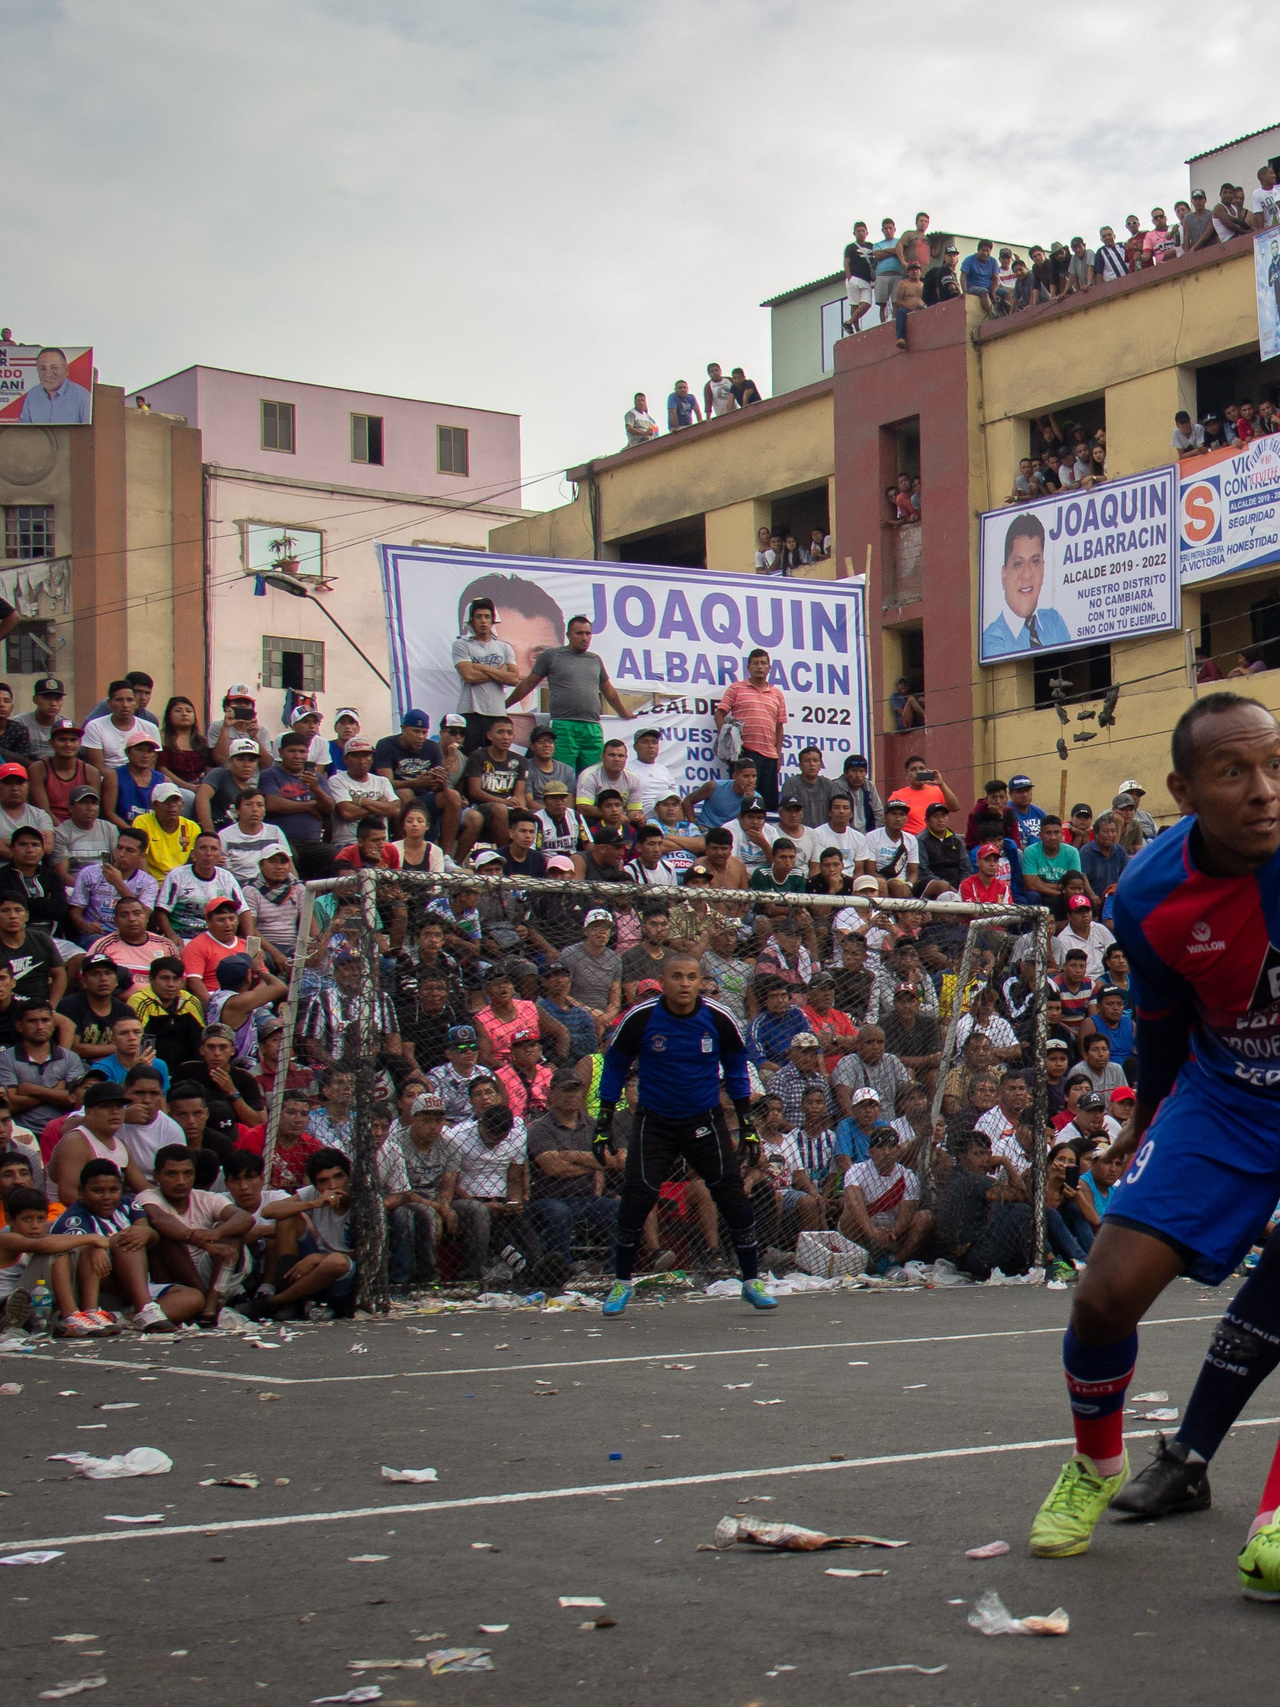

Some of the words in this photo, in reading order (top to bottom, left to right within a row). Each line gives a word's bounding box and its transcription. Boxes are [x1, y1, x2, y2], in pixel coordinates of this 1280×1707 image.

[1049, 481, 1167, 541] JOAQUIN
[1230, 498, 1257, 510] ALCALDE
[1257, 495, 1270, 505] 2019
[1184, 485, 1215, 542] S
[1228, 508, 1275, 529] SEGURIDAD
[1250, 526, 1256, 536] Y
[1063, 523, 1167, 565] ALBARRACIN
[1180, 553, 1190, 562] ERÚ
[1206, 545, 1224, 557] SEGURA
[1226, 533, 1278, 555] HONESTIDAD
[1063, 564, 1107, 585] ALCALDE
[1109, 559, 1133, 576] 2019
[1142, 553, 1167, 569] 2022
[1189, 554, 1225, 572] VICTORIA
[1077, 582, 1120, 599] NUESTRO
[1123, 573, 1166, 590] DISTRITO
[1089, 598, 1102, 609] NO
[1105, 586, 1153, 606] CAMBIARÁ
[582, 583, 848, 653] JOAQUIN
[1077, 622, 1096, 637] SINO
[1098, 621, 1114, 634] CON
[1130, 611, 1167, 627] EJEMPLO
[1087, 609, 1104, 622] CON
[1106, 607, 1118, 618] TU
[616, 648, 851, 695] ALBARACIN
[801, 706, 851, 726] 2022
[687, 746, 714, 761] NO
[782, 735, 850, 752] STRITO
[685, 766, 721, 781] CON
[1186, 941, 1226, 953] WALON
[10, 956, 33, 973] NIKE
[1126, 1140, 1155, 1184] 9
